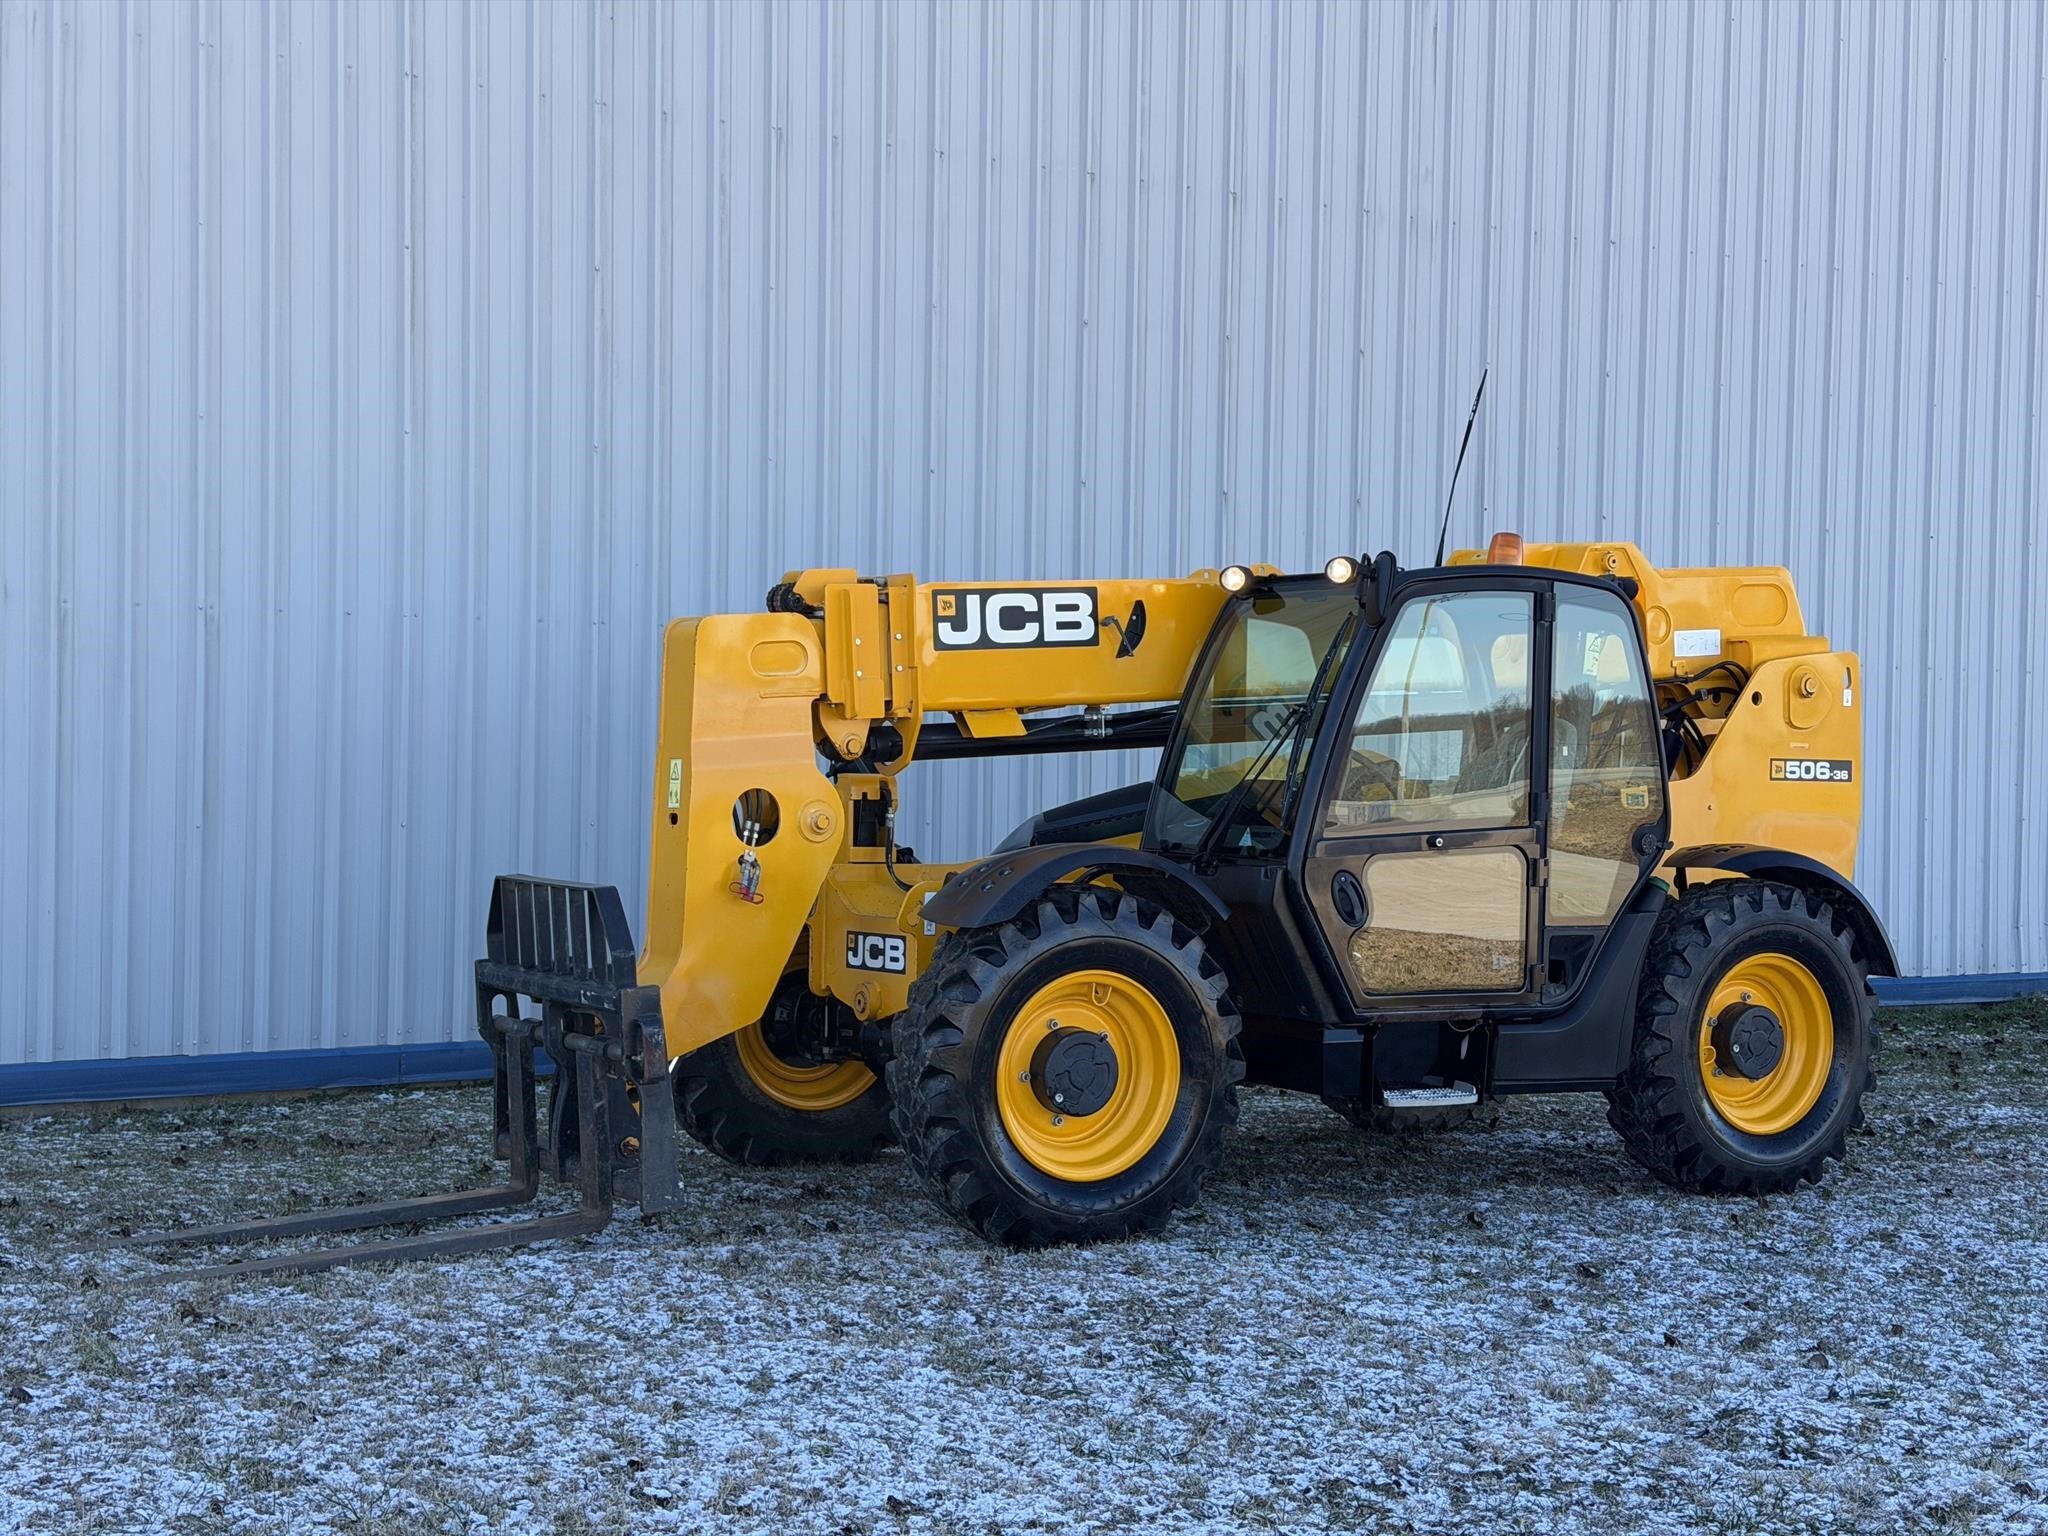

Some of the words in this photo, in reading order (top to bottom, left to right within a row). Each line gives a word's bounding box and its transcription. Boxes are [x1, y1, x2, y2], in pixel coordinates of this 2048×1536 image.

[937, 592, 1095, 645] JCB
[1786, 761, 1848, 780] 506-36
[848, 935, 904, 970] JCB
